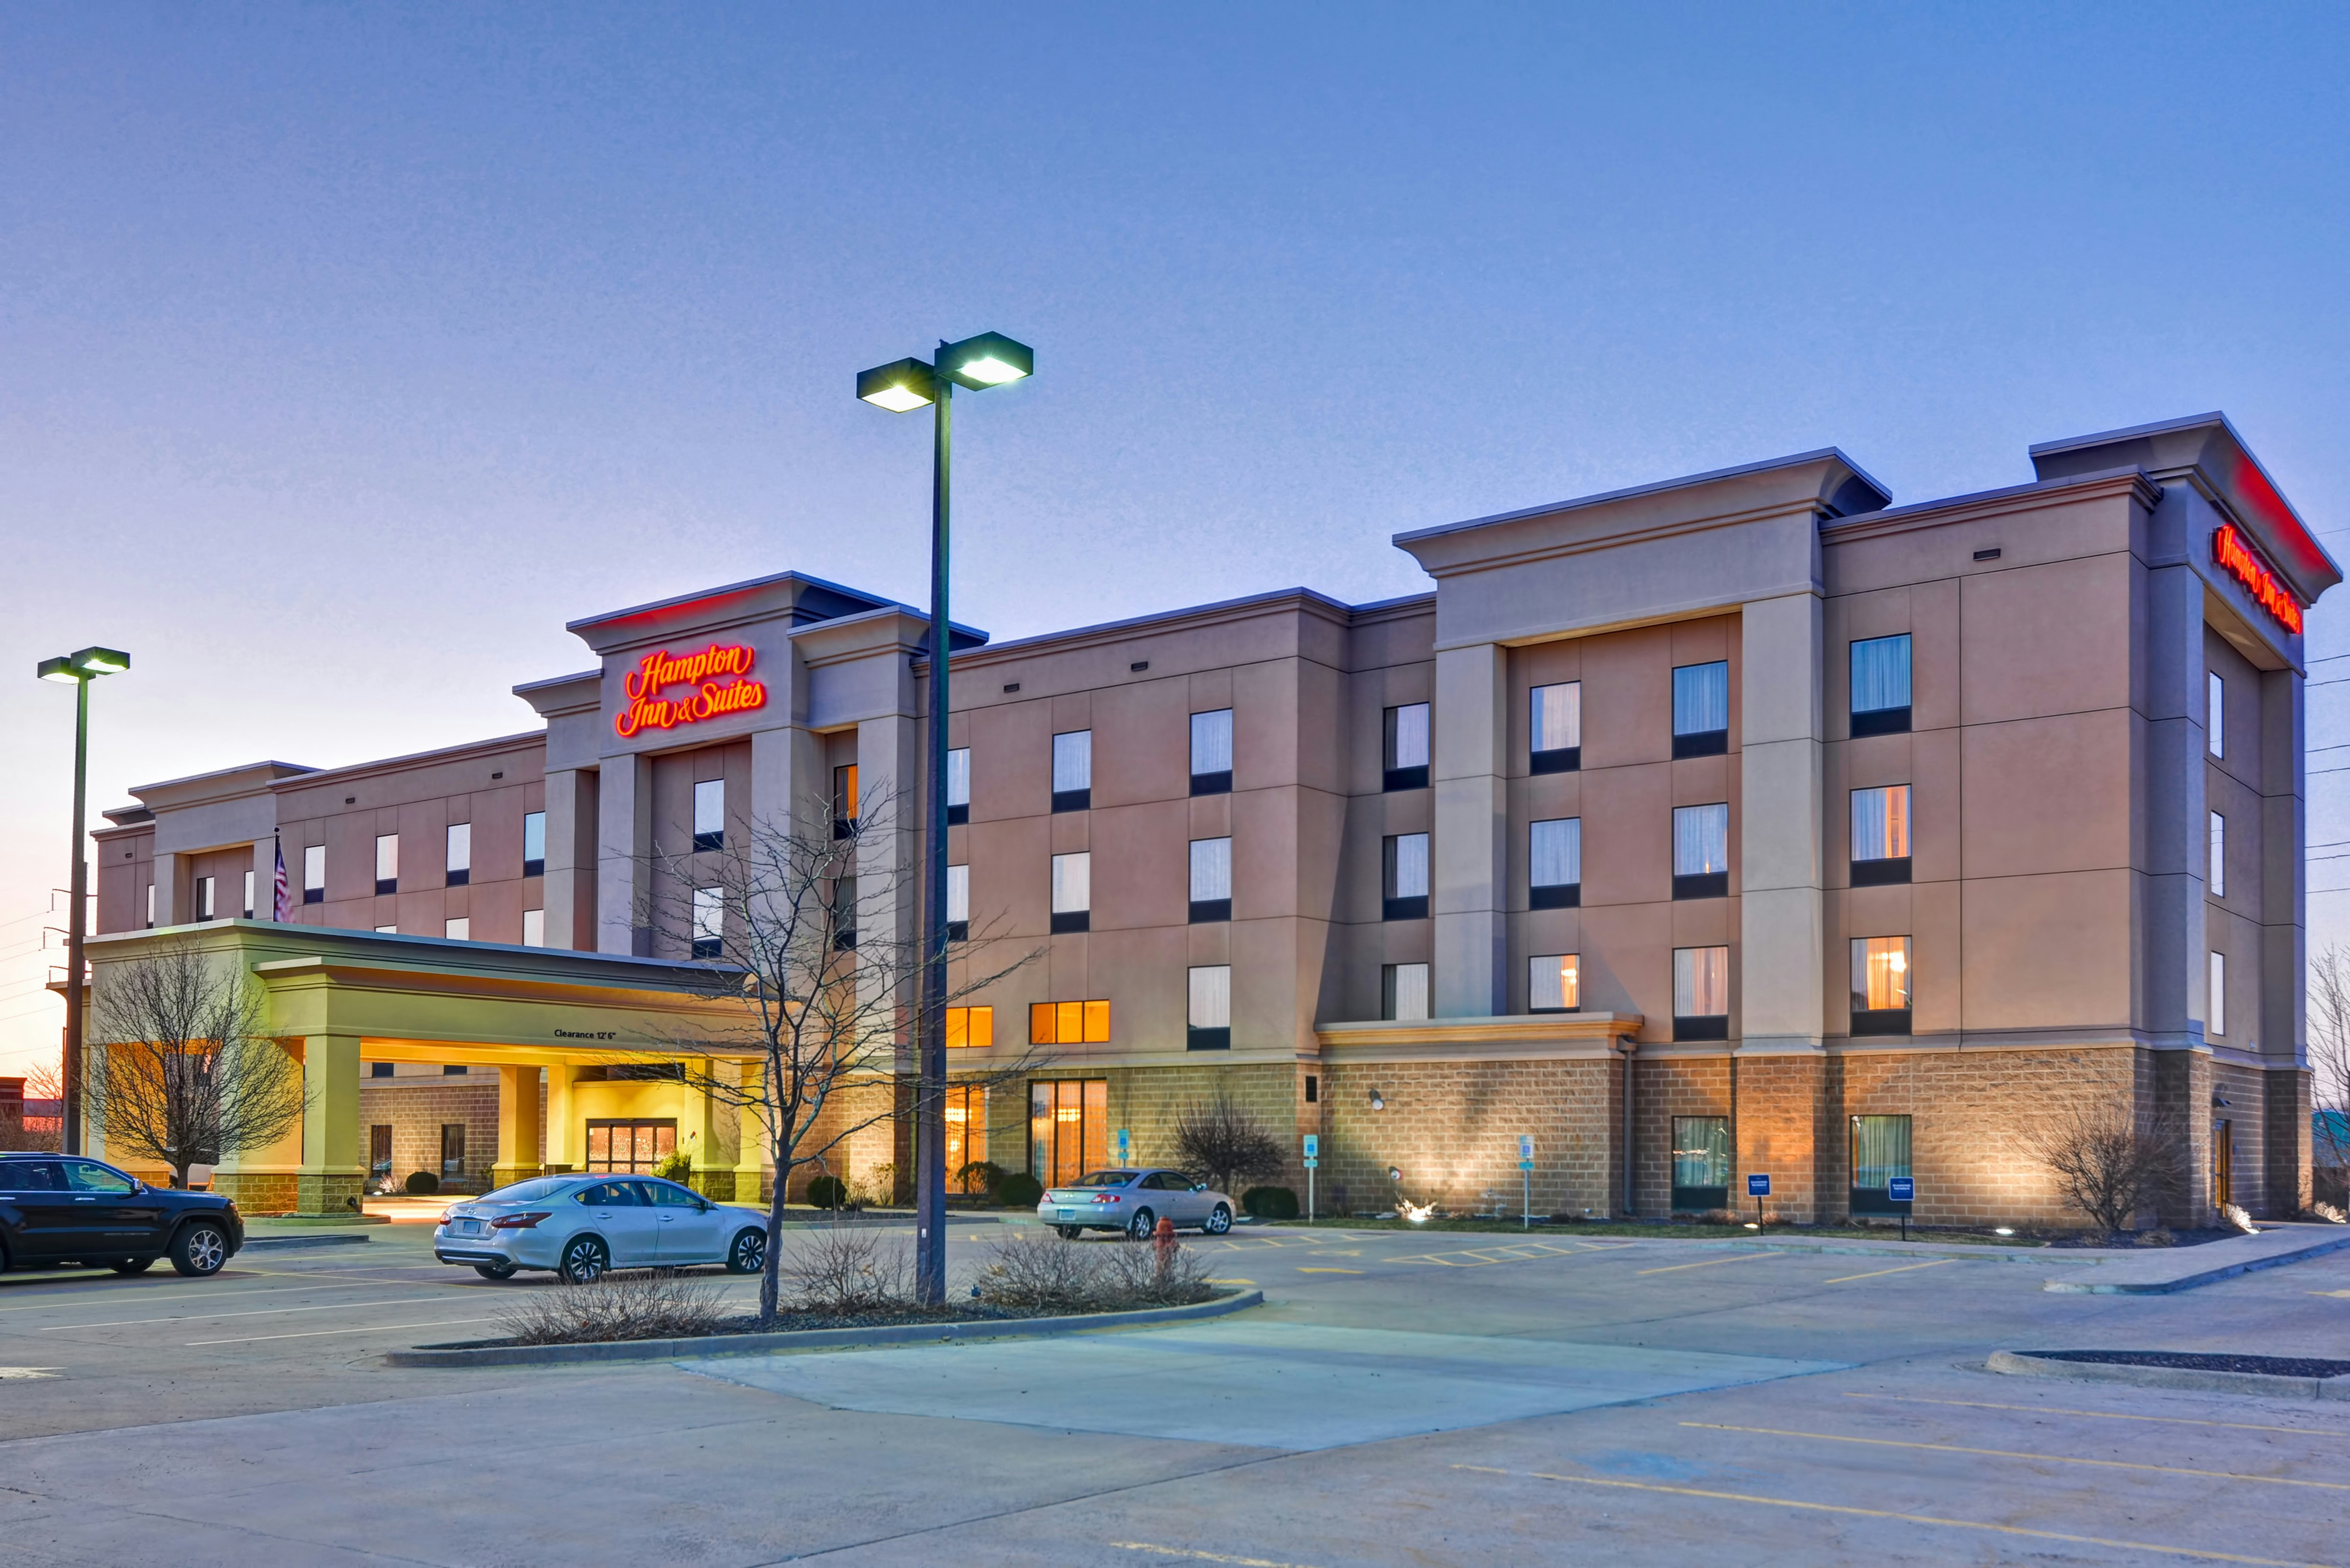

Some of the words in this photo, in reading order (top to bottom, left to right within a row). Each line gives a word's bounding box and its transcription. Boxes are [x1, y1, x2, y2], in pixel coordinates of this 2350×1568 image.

[626, 644, 755, 700] Hampton
[616, 696, 678, 736] Inn
[677, 698, 695, 722] &
[692, 679, 765, 718] Suites
[554, 1029, 594, 1039] Clearance
